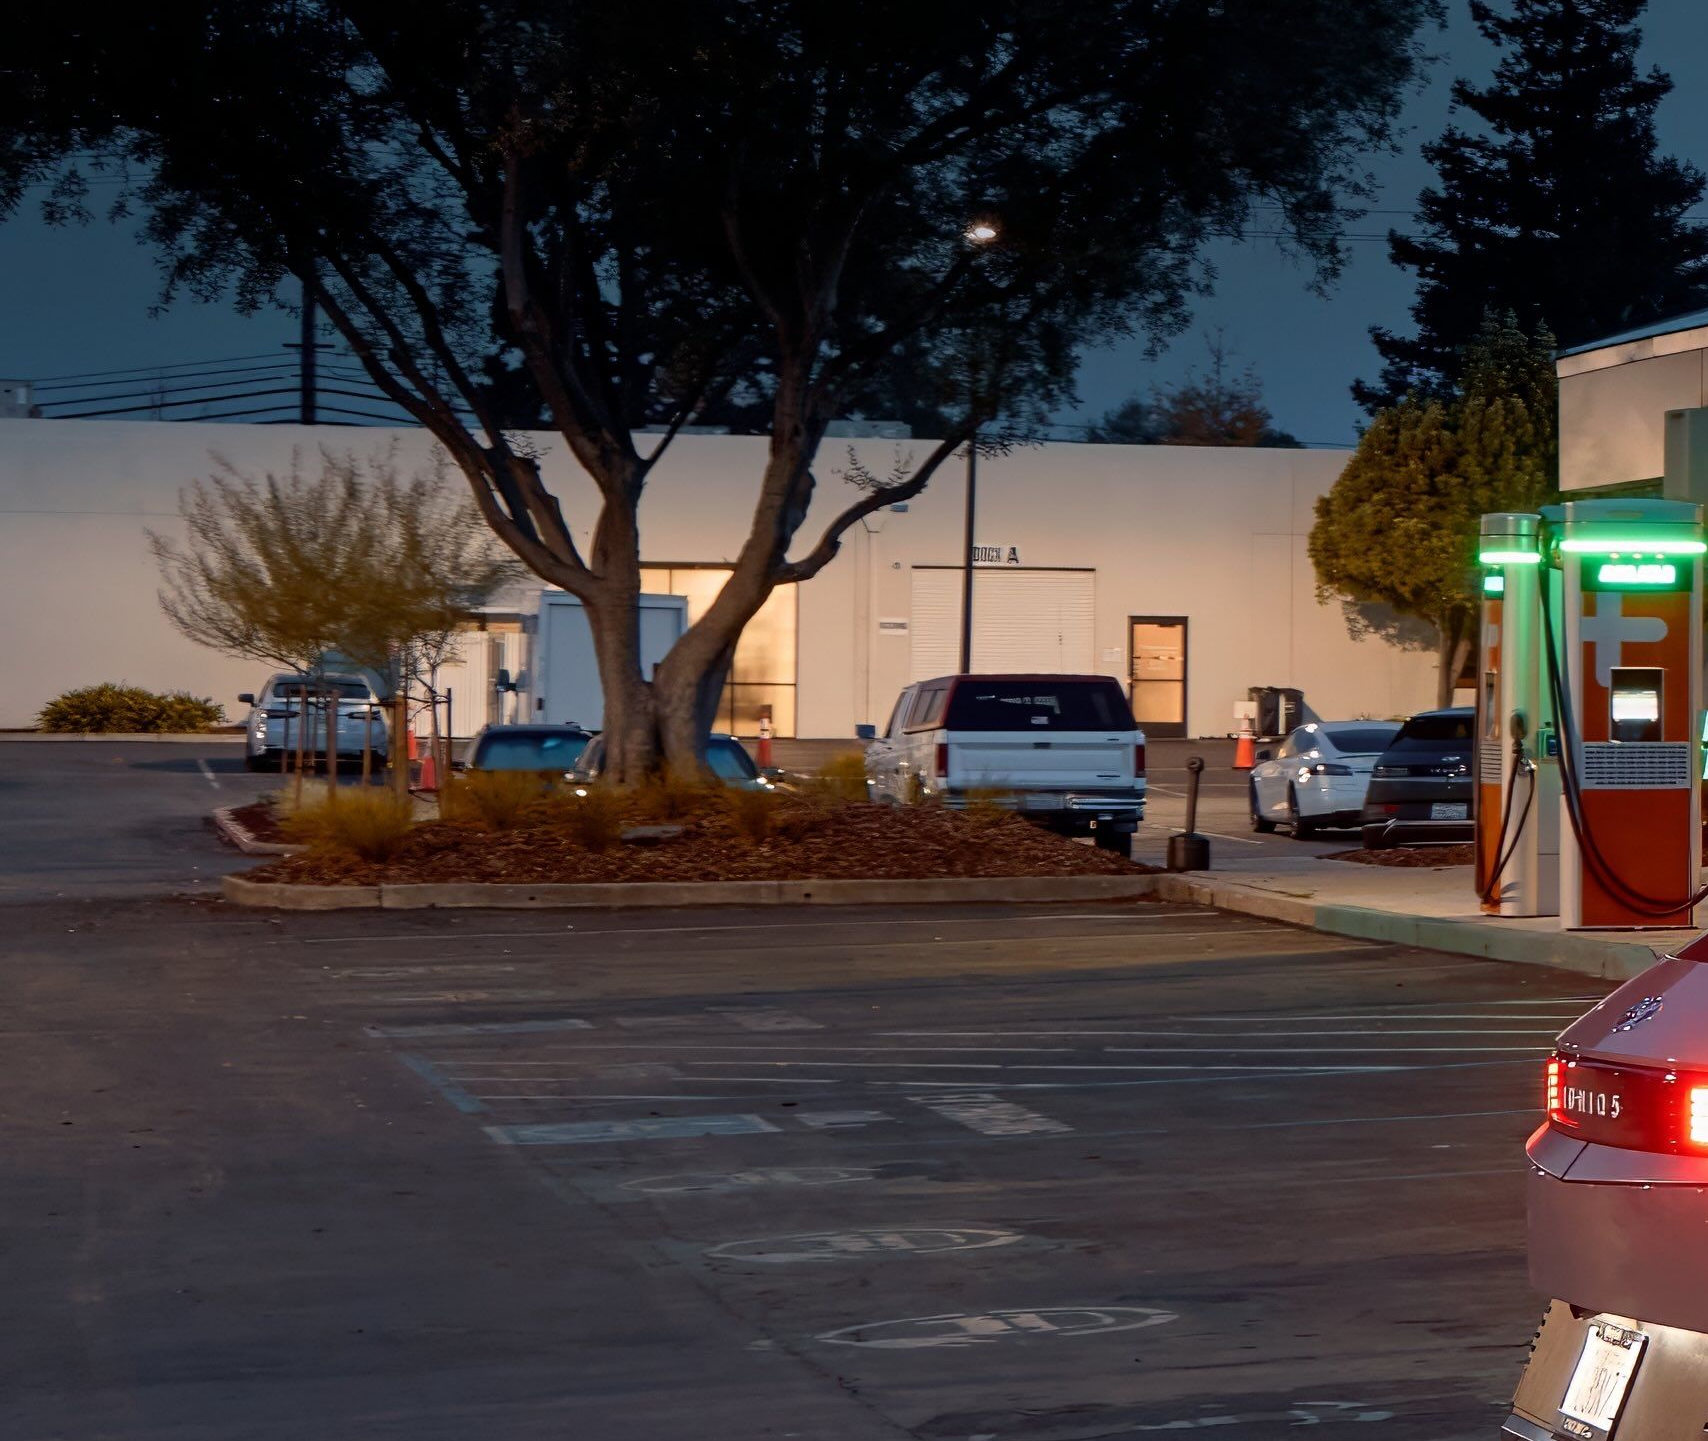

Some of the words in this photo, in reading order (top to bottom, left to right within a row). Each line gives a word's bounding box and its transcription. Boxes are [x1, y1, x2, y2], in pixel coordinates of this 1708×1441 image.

[1006, 546, 1020, 564] A
[1563, 1085, 1606, 1116] IONIQ
[1610, 1094, 1621, 1119] 5
